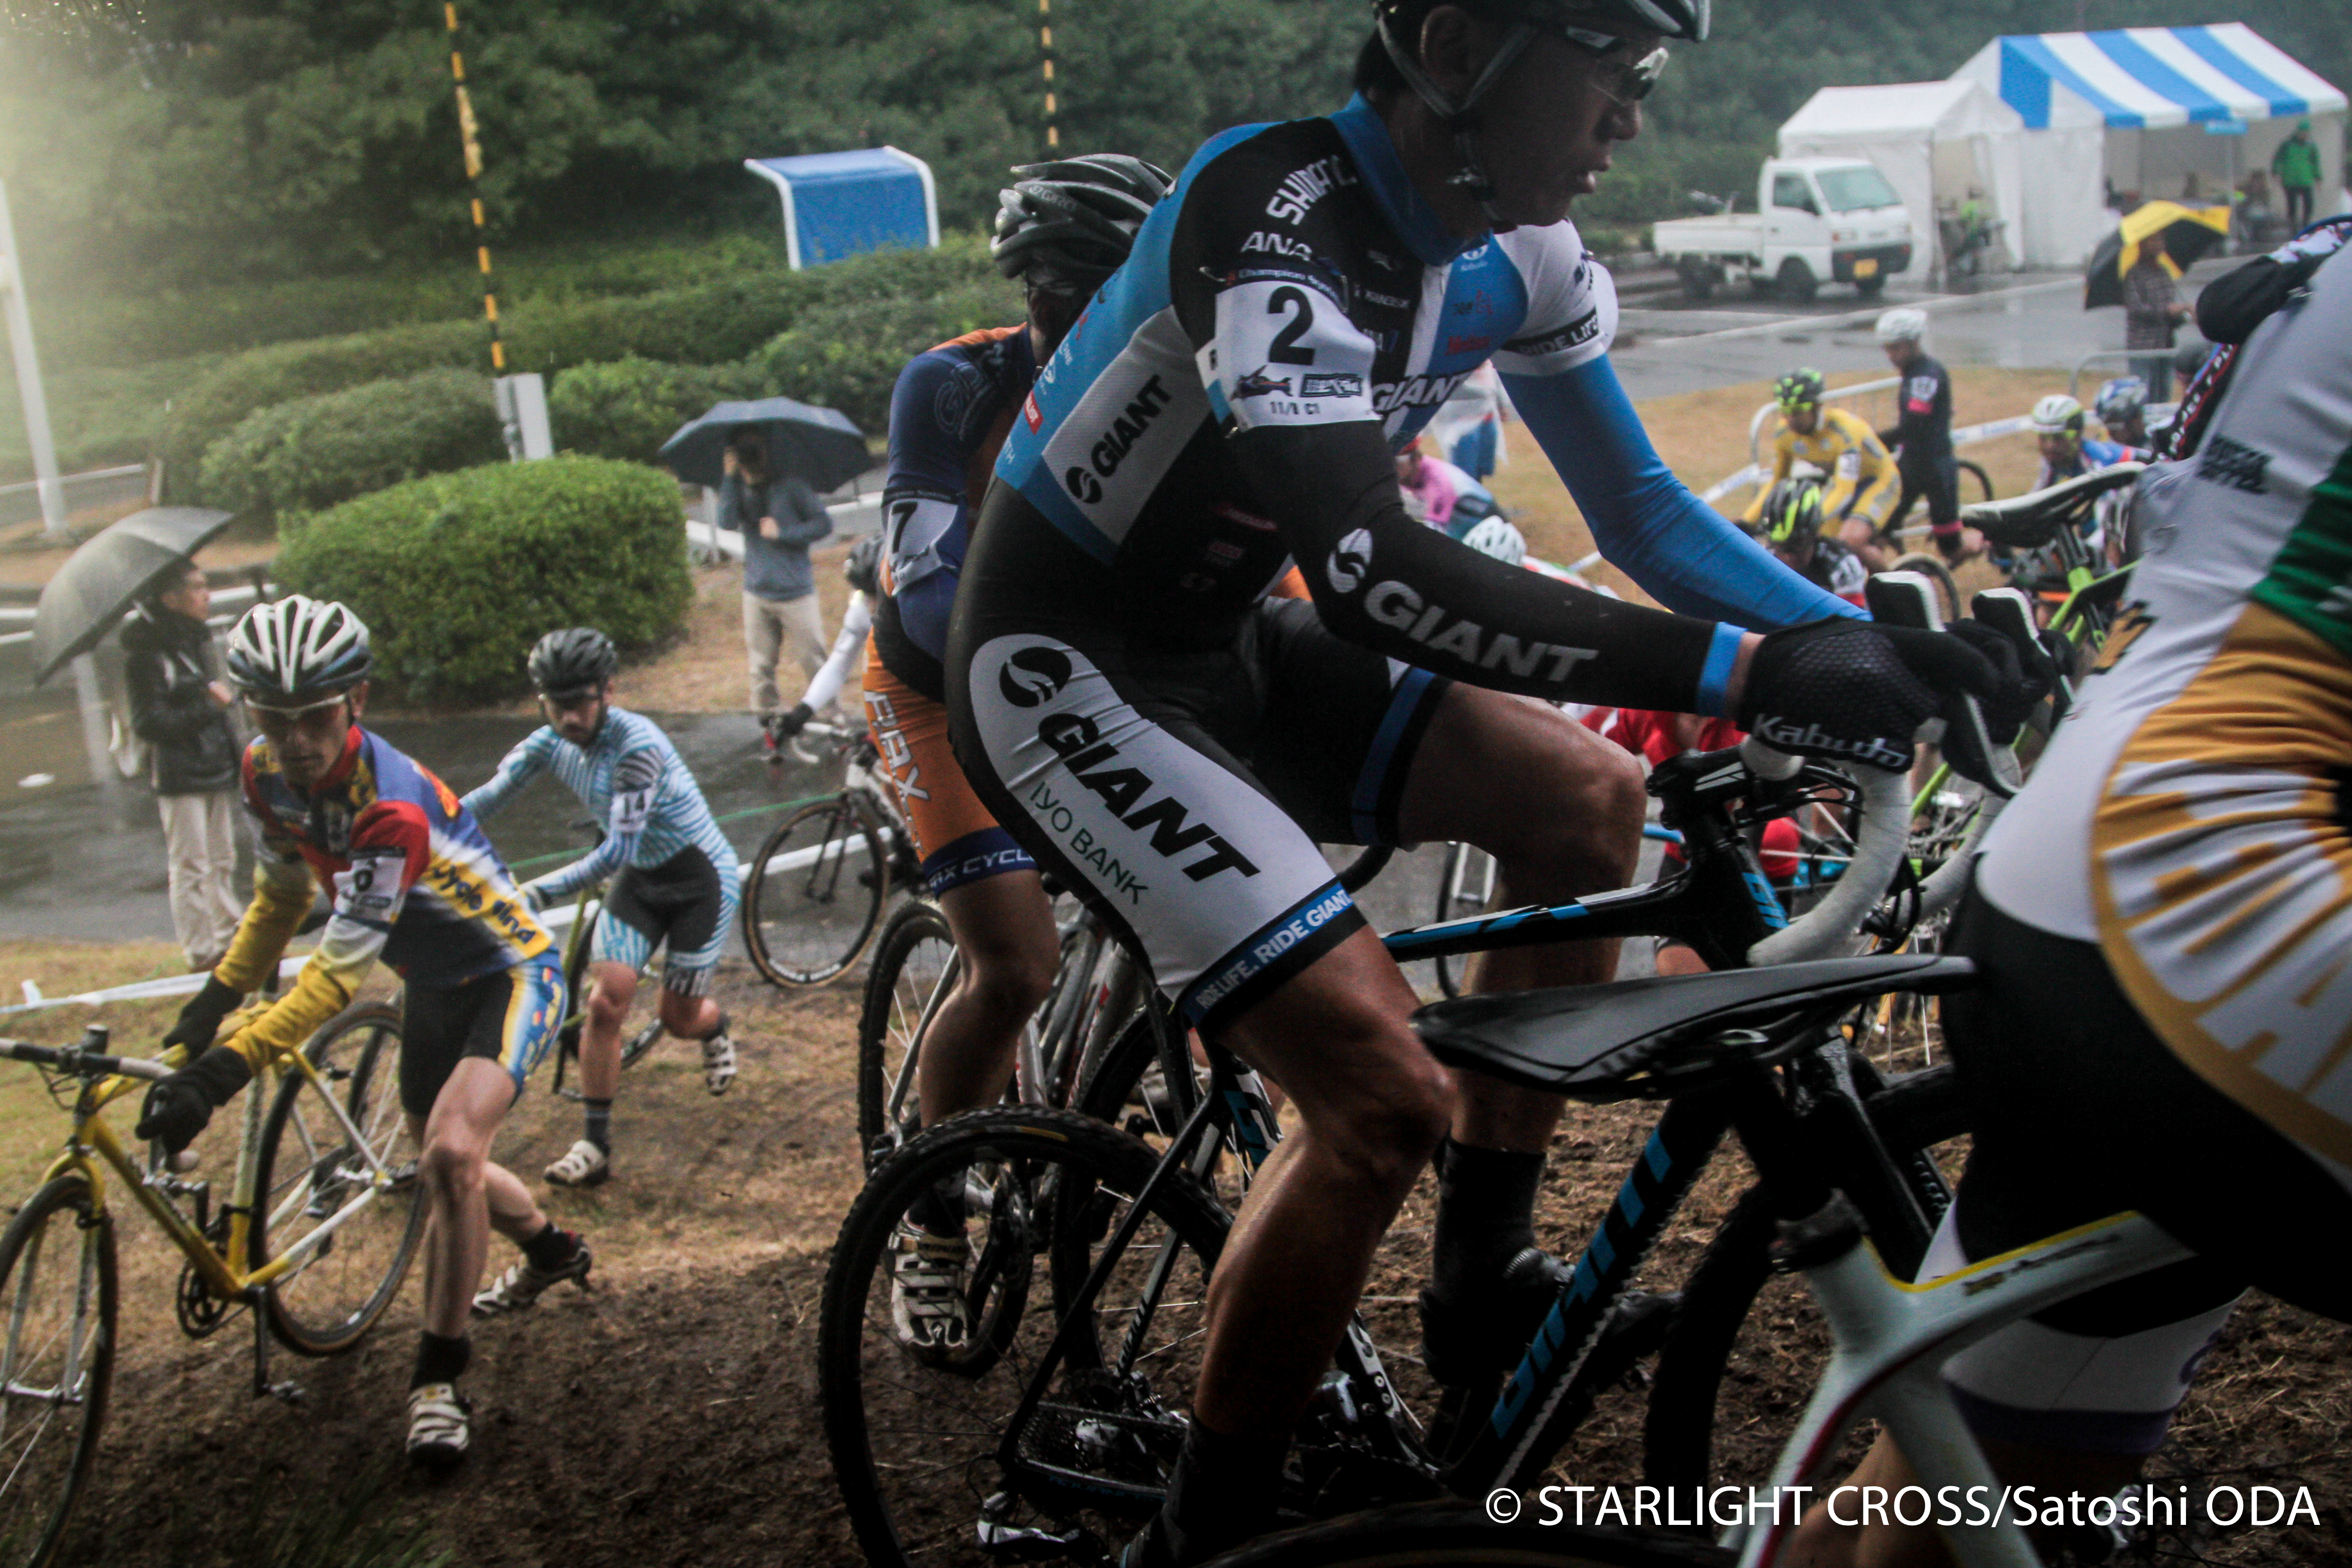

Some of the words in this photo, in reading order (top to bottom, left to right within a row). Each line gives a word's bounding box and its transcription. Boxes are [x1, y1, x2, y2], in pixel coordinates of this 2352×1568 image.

[1269, 286, 1314, 366] 2
[1091, 374, 1171, 477] GIANT
[891, 501, 917, 554] 7
[1364, 580, 1599, 683] GIANT
[1029, 781, 1073, 834] IYO
[1069, 828, 1149, 905] BANK
[1038, 713, 1261, 882] GIANT
[961, 848, 1035, 875] CYCL
[1253, 919, 1309, 964] RIDE
